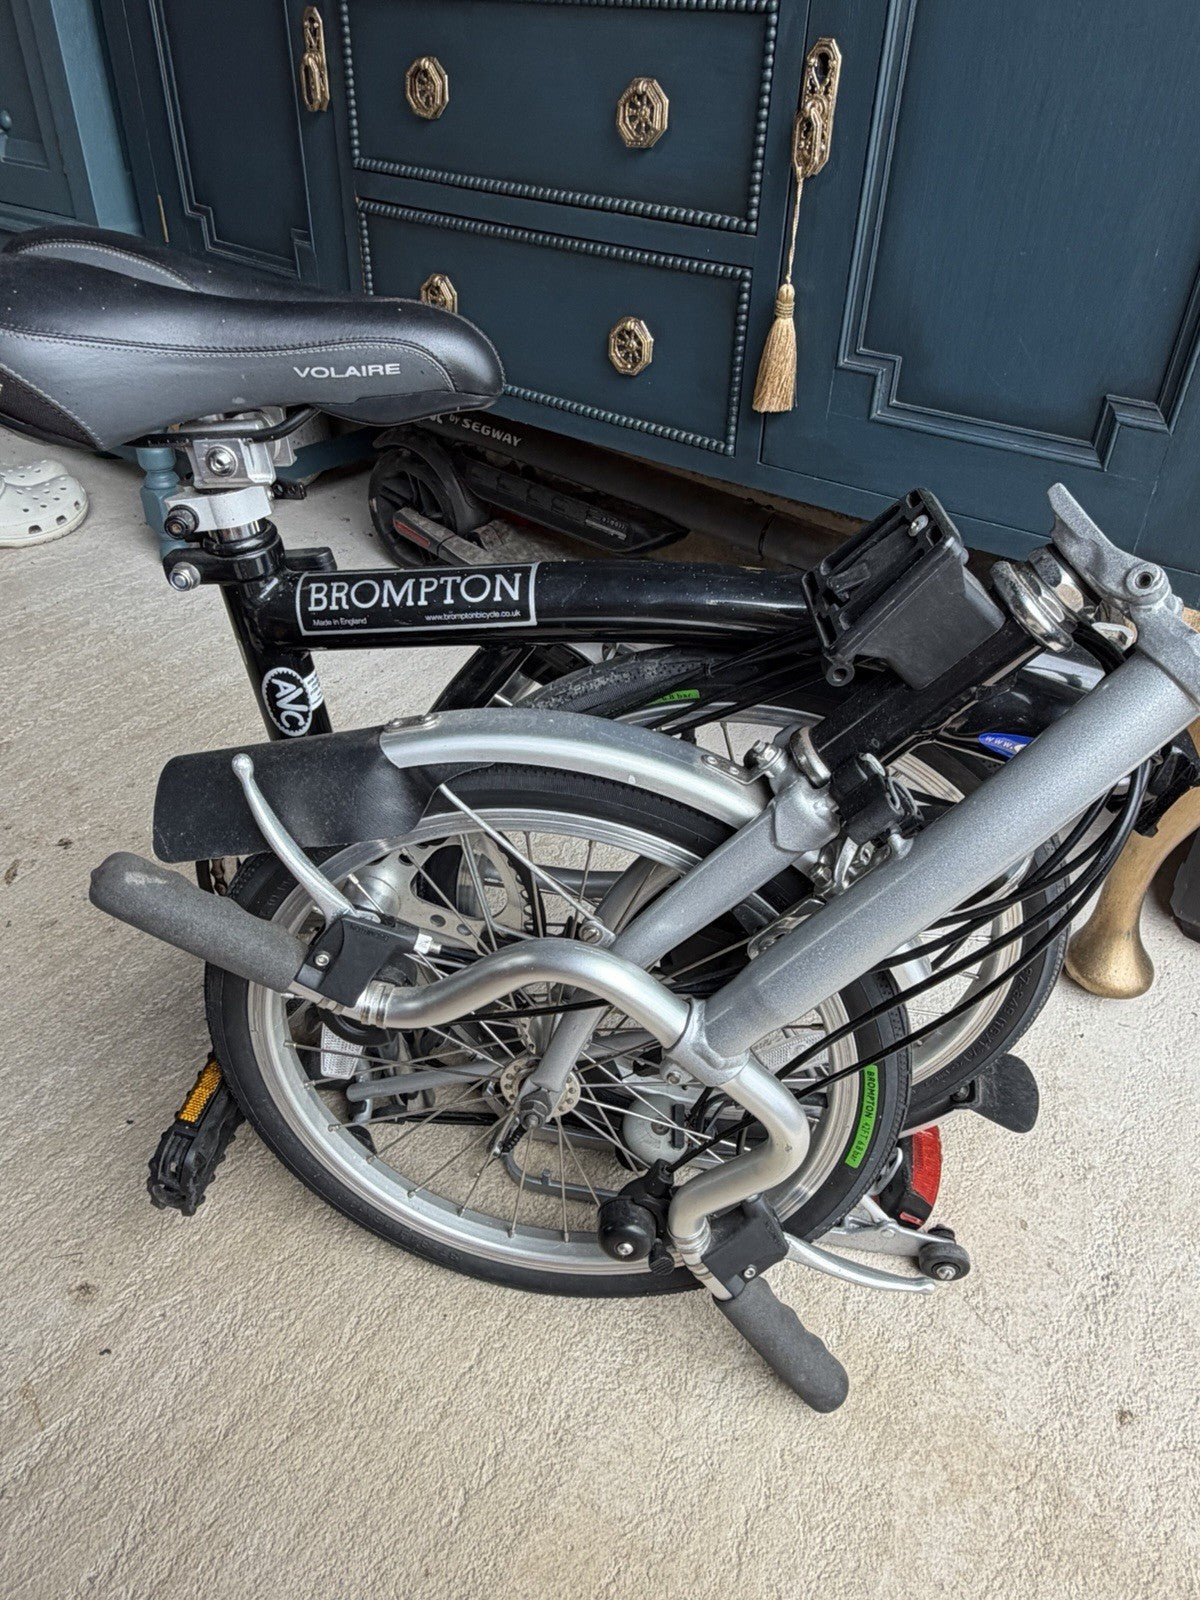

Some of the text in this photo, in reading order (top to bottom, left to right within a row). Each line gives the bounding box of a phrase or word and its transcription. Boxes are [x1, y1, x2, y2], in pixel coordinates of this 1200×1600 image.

[293, 362, 402, 379] VOLAIRE
[461, 418, 522, 447] SEGWAY
[307, 572, 522, 612] BROMPTON
[312, 616, 368, 627] Made in England
[864, 1070, 877, 1119] BROMPTON
